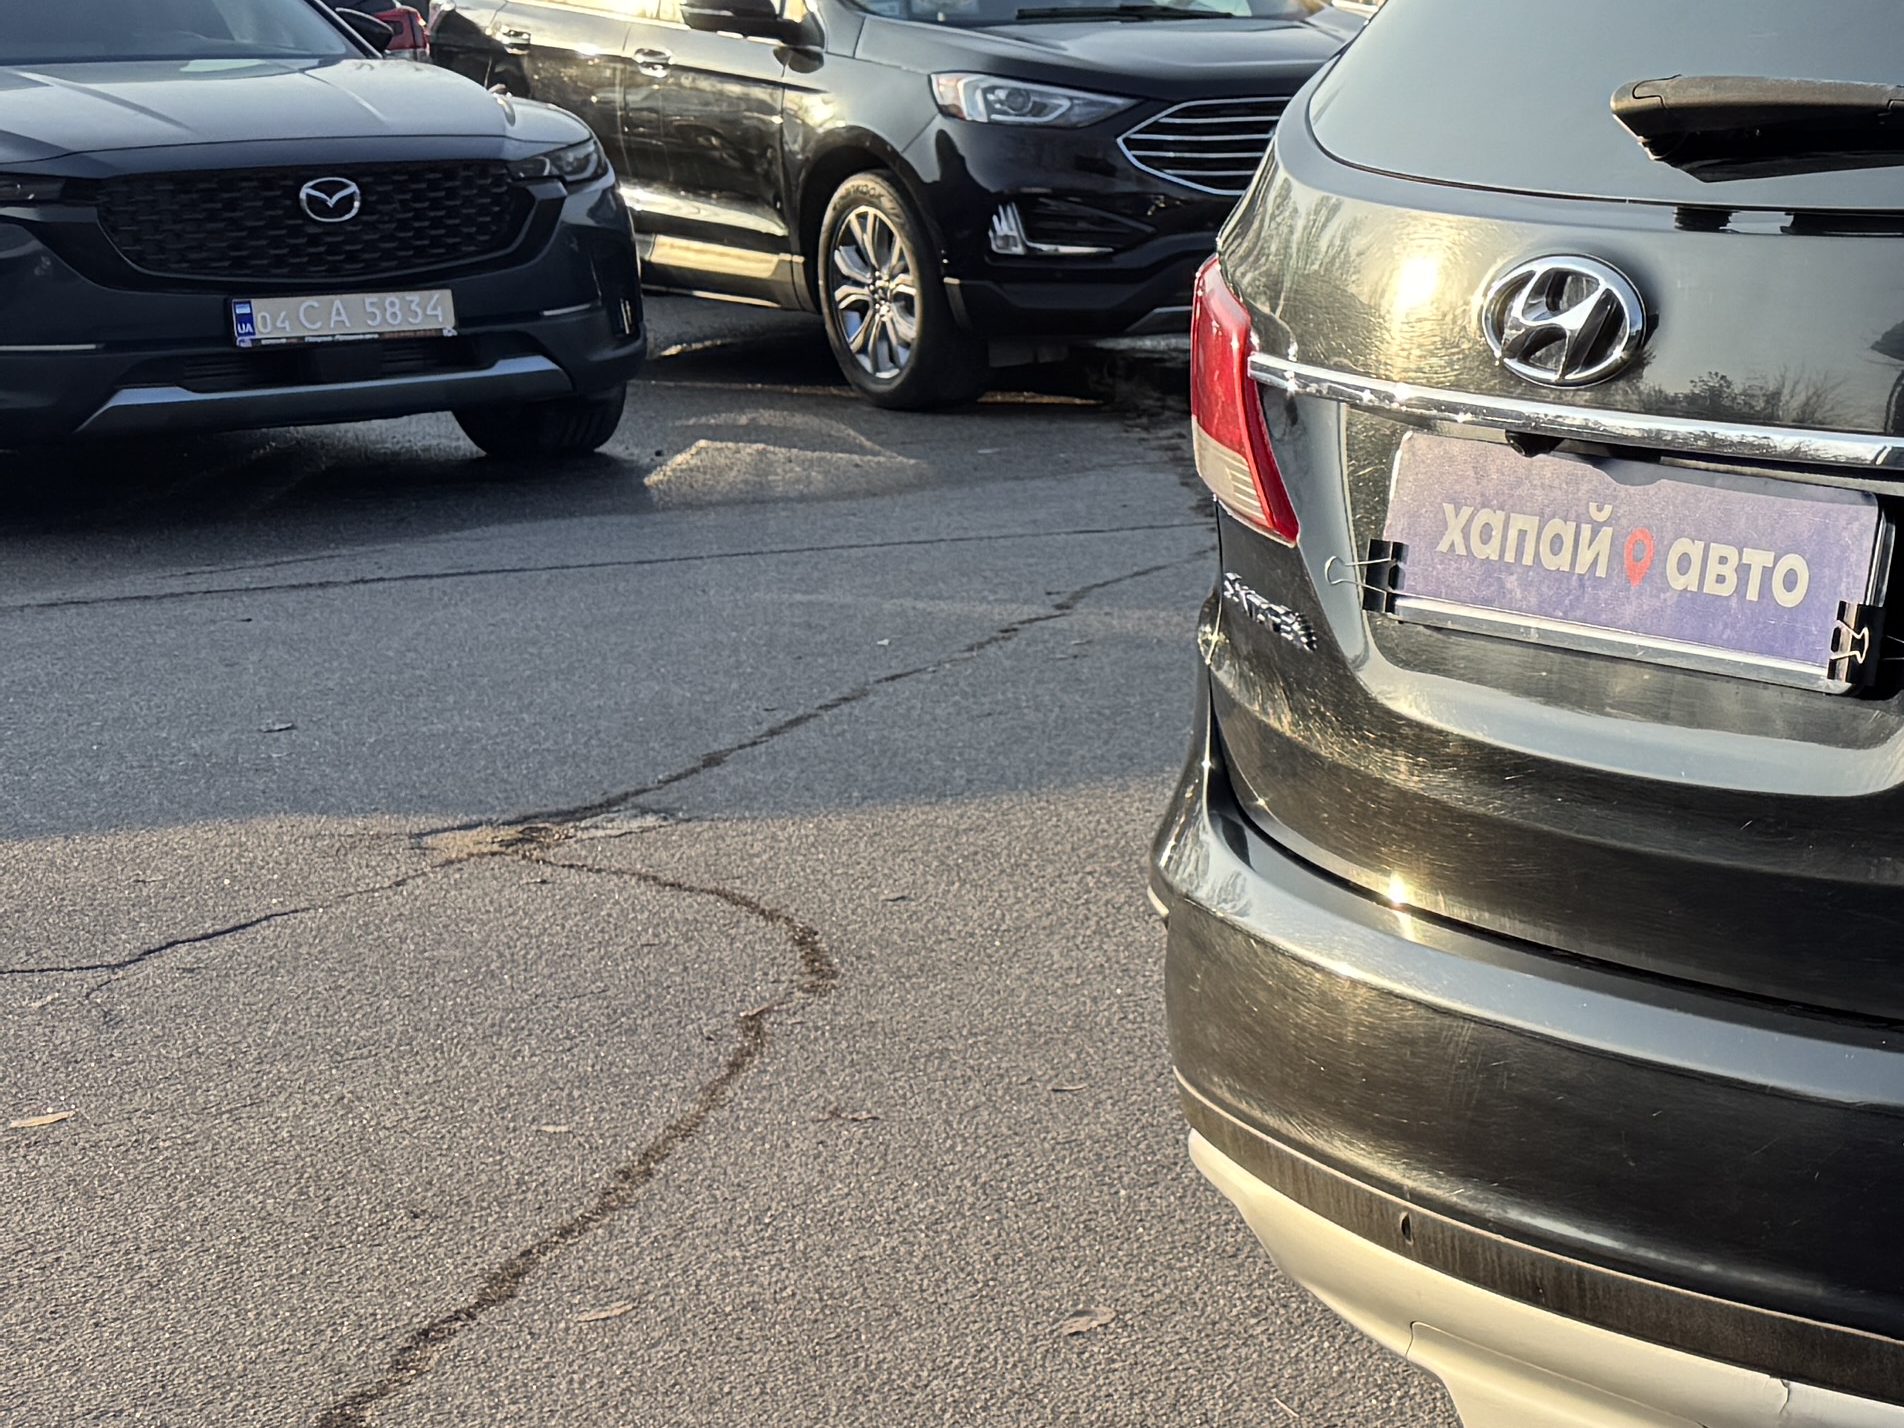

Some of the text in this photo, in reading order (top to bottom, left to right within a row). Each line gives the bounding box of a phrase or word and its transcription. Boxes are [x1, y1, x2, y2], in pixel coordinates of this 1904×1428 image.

[237, 322, 254, 334] UA
[256, 292, 444, 334] 04 CA 5834
[1436, 501, 1810, 609] хапай авто
